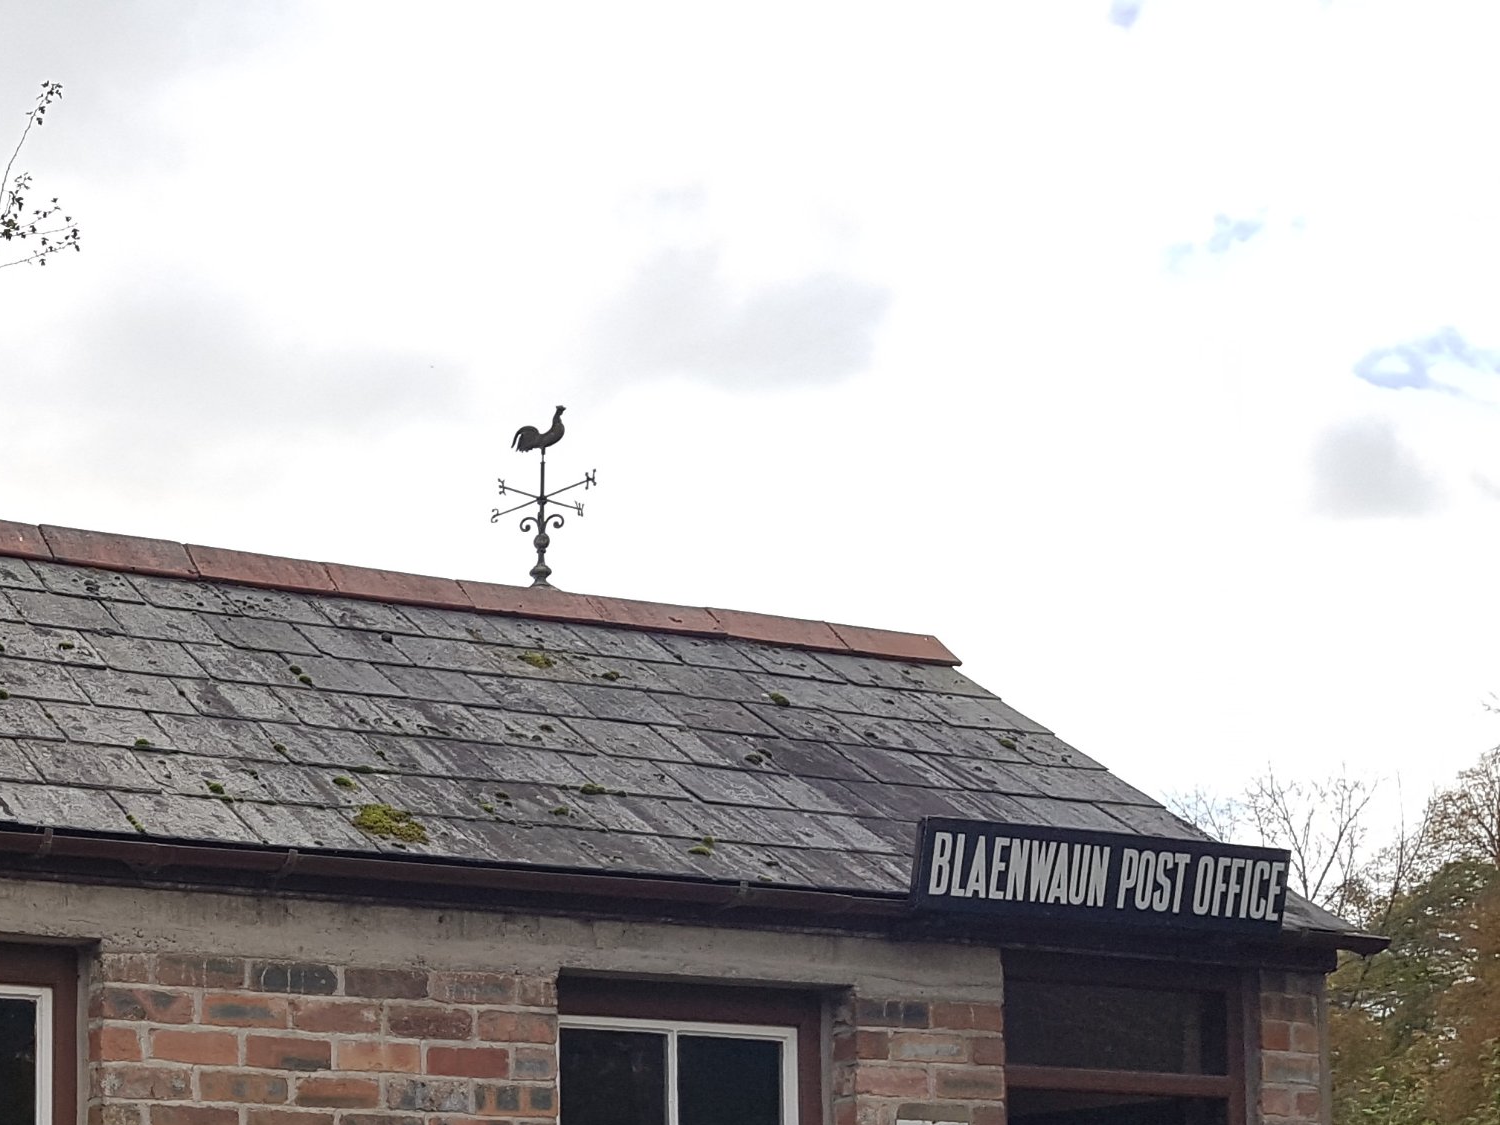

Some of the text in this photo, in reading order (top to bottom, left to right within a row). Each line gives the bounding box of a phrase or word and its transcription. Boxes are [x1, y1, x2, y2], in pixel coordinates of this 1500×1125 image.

[928, 832, 1285, 922] BLAENWAUN POST OFFICE
